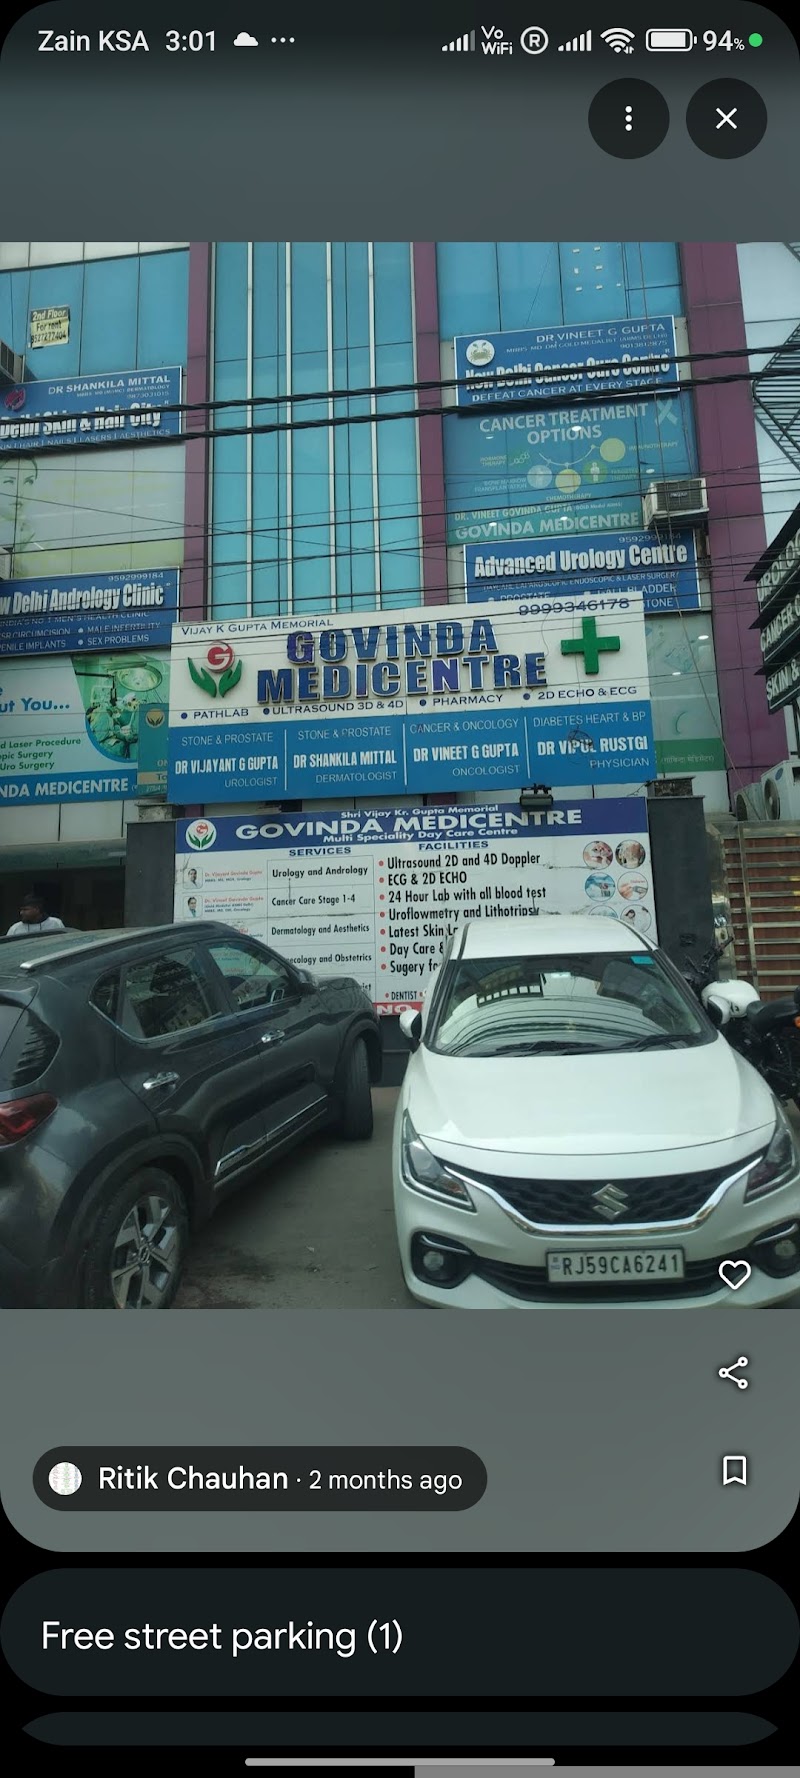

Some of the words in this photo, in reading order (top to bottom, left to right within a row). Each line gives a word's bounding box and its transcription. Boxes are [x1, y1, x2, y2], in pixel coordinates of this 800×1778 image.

[32, 310, 46, 321] 2nd
[48, 309, 67, 319] Floor
[556, 329, 603, 341] VINEET
[621, 323, 665, 334] GUPTA
[496, 362, 532, 388] Delhi
[534, 360, 584, 385] Cancer
[621, 352, 671, 377] Centre
[66, 380, 125, 393] SHANKILA
[128, 375, 171, 386] MITTAL
[472, 391, 516, 402] DEFEAT
[518, 386, 566, 398] CANCER
[569, 384, 582, 393] AT
[585, 380, 622, 391] EVERY
[43, 410, 77, 435] Skin
[94, 405, 125, 430] Hair
[130, 402, 161, 427] City
[479, 412, 546, 434] CANCER
[548, 403, 649, 427] TREATMENT
[527, 425, 603, 445] OPTIONS
[454, 511, 470, 521] DR.
[471, 508, 500, 519] VINEET
[502, 505, 542, 517] GOVINDA
[544, 503, 573, 514] GUPTA
[455, 520, 535, 540] GOVINDA
[539, 511, 639, 533] MEDICENTRE
[474, 550, 556, 579] Advanced
[559, 547, 626, 573] Urology
[628, 543, 688, 567] Centre
[108, 572, 164, 582] 9592999184
[569, 576, 616, 586] ENDOSCOPIC
[622, 573, 646, 581] LASER
[646, 571, 680, 580] SURGERY
[13, 588, 48, 616] Delhi
[49, 585, 120, 613] Andrology
[123, 582, 164, 608] Clinic
[518, 597, 630, 616] 9999346178
[87, 626, 111, 634] MALE
[181, 625, 215, 636] VIJAY
[228, 622, 268, 633] GUPTA
[270, 618, 334, 630] MEMORIAL
[760, 602, 793, 653] CANCER
[26, 640, 66, 650] IMPLANTS
[87, 637, 103, 646] SEX
[105, 634, 150, 645] PROBLEMS
[286, 619, 499, 665] GOVINDA
[257, 651, 548, 705] MEDICENTRE
[766, 666, 789, 701] SKIN
[432, 694, 503, 707] PHARMACY
[537, 690, 555, 700] 2D
[557, 687, 595, 699] ECHO
[610, 685, 637, 696] ECG
[193, 707, 249, 720] PATHLAB
[272, 701, 354, 715] ULTRASOUND
[357, 700, 375, 710] 3D
[387, 699, 404, 709] 4D
[409, 721, 451, 735] CANCER
[462, 717, 519, 732] ONCOLOGY
[533, 714, 584, 728] DIABETES
[585, 712, 621, 725] HEART
[633, 711, 646, 722] BP
[181, 735, 214, 747] STONE
[224, 731, 274, 744] PROSTATE
[297, 729, 330, 741] STONE
[341, 725, 392, 738] PROSTATE
[9, 740, 33, 749] Laser
[35, 737, 82, 748] Procedure
[431, 745, 470, 761] VINEET
[481, 742, 520, 758] GUPTA
[599, 735, 648, 752] RUSTGI
[18, 751, 54, 761] Surgery
[190, 756, 238, 774] VIJAYANT
[247, 755, 279, 770] GUPTA
[309, 751, 358, 768] SHANKILA
[359, 749, 397, 765] MITTAL
[589, 757, 650, 769] PHYSICIAN
[19, 761, 55, 771] Surgery
[452, 764, 520, 777] ONCOLOGIST
[224, 776, 278, 788] UROLOGIST
[315, 770, 398, 784] DERMATOLOGIST
[34, 777, 130, 796] MEDICENTRE
[341, 810, 361, 819] Shri
[364, 809, 392, 819] Vijay
[394, 808, 410, 817] Kr.
[412, 806, 445, 817] Gupta
[447, 804, 499, 815] Memorial
[235, 819, 384, 841] GOVINDA
[393, 809, 583, 834] MEDICENTRE
[323, 834, 354, 844] Multi
[357, 831, 414, 844] Speciality
[417, 829, 443, 841] Day
[446, 828, 476, 838] Care
[478, 826, 518, 837] Centre
[288, 846, 352, 858] SERVICES
[418, 839, 490, 852] FACILITIES
[387, 855, 442, 871] Ultrasound
[444, 854, 459, 867] 2D
[483, 853, 498, 865] 4D
[501, 851, 541, 868] Doppler
[271, 868, 305, 880] Urology
[325, 865, 369, 878] Andrology
[388, 873, 408, 887] ECG
[422, 872, 436, 885] 2D
[439, 871, 468, 884] ECHO
[271, 896, 296, 907] Cancer
[298, 896, 315, 906] Care
[318, 895, 340, 907] Stage
[342, 894, 356, 904] 1-4
[388, 890, 402, 904] 24
[405, 889, 429, 903] Hour
[432, 889, 450, 902] Lab
[453, 887, 477, 901] with
[479, 887, 492, 900] all
[495, 886, 524, 899] blood
[526, 886, 547, 899] test
[388, 906, 460, 922] Uroflowmetry
[485, 904, 540, 917] Lithotripsy
[271, 925, 316, 938] Dermatology
[333, 923, 370, 935] Aesthetics
[388, 924, 420, 938] Latest
[423, 923, 444, 937] Skin
[389, 942, 410, 958] Day
[412, 941, 436, 955] Care
[334, 953, 373, 964] Obstetrics
[389, 959, 425, 977] Sugery
[391, 990, 418, 1001] DENTIST
[562, 1253, 679, 1276] RJ59CA6241
